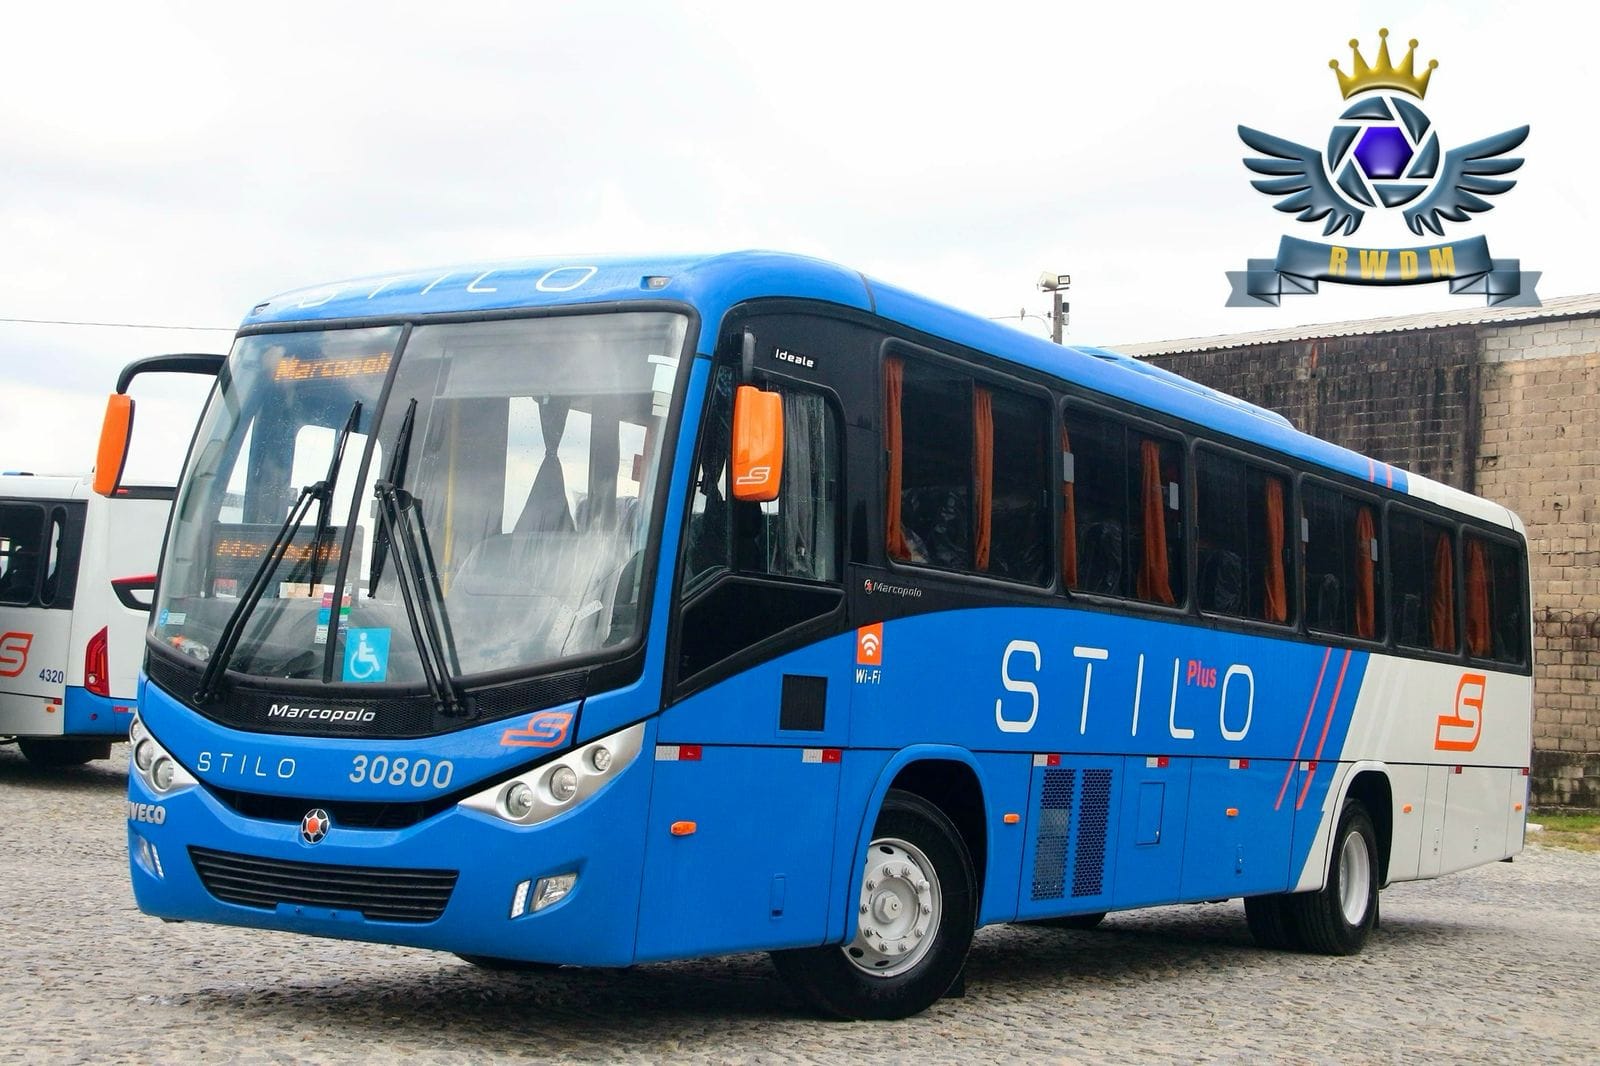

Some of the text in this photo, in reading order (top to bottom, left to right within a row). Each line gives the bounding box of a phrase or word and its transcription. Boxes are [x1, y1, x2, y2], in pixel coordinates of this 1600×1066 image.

[775, 348, 815, 368] Ideale
[873, 582, 922, 597] Marcopolo
[39, 668, 64, 684] 4320
[855, 668, 881, 685] Wi-Fi
[1186, 660, 1217, 688] Plus
[995, 639, 1255, 741] STILO
[268, 704, 376, 723] Marcopolo
[197, 751, 297, 779] STILO
[349, 755, 454, 790] 30800
